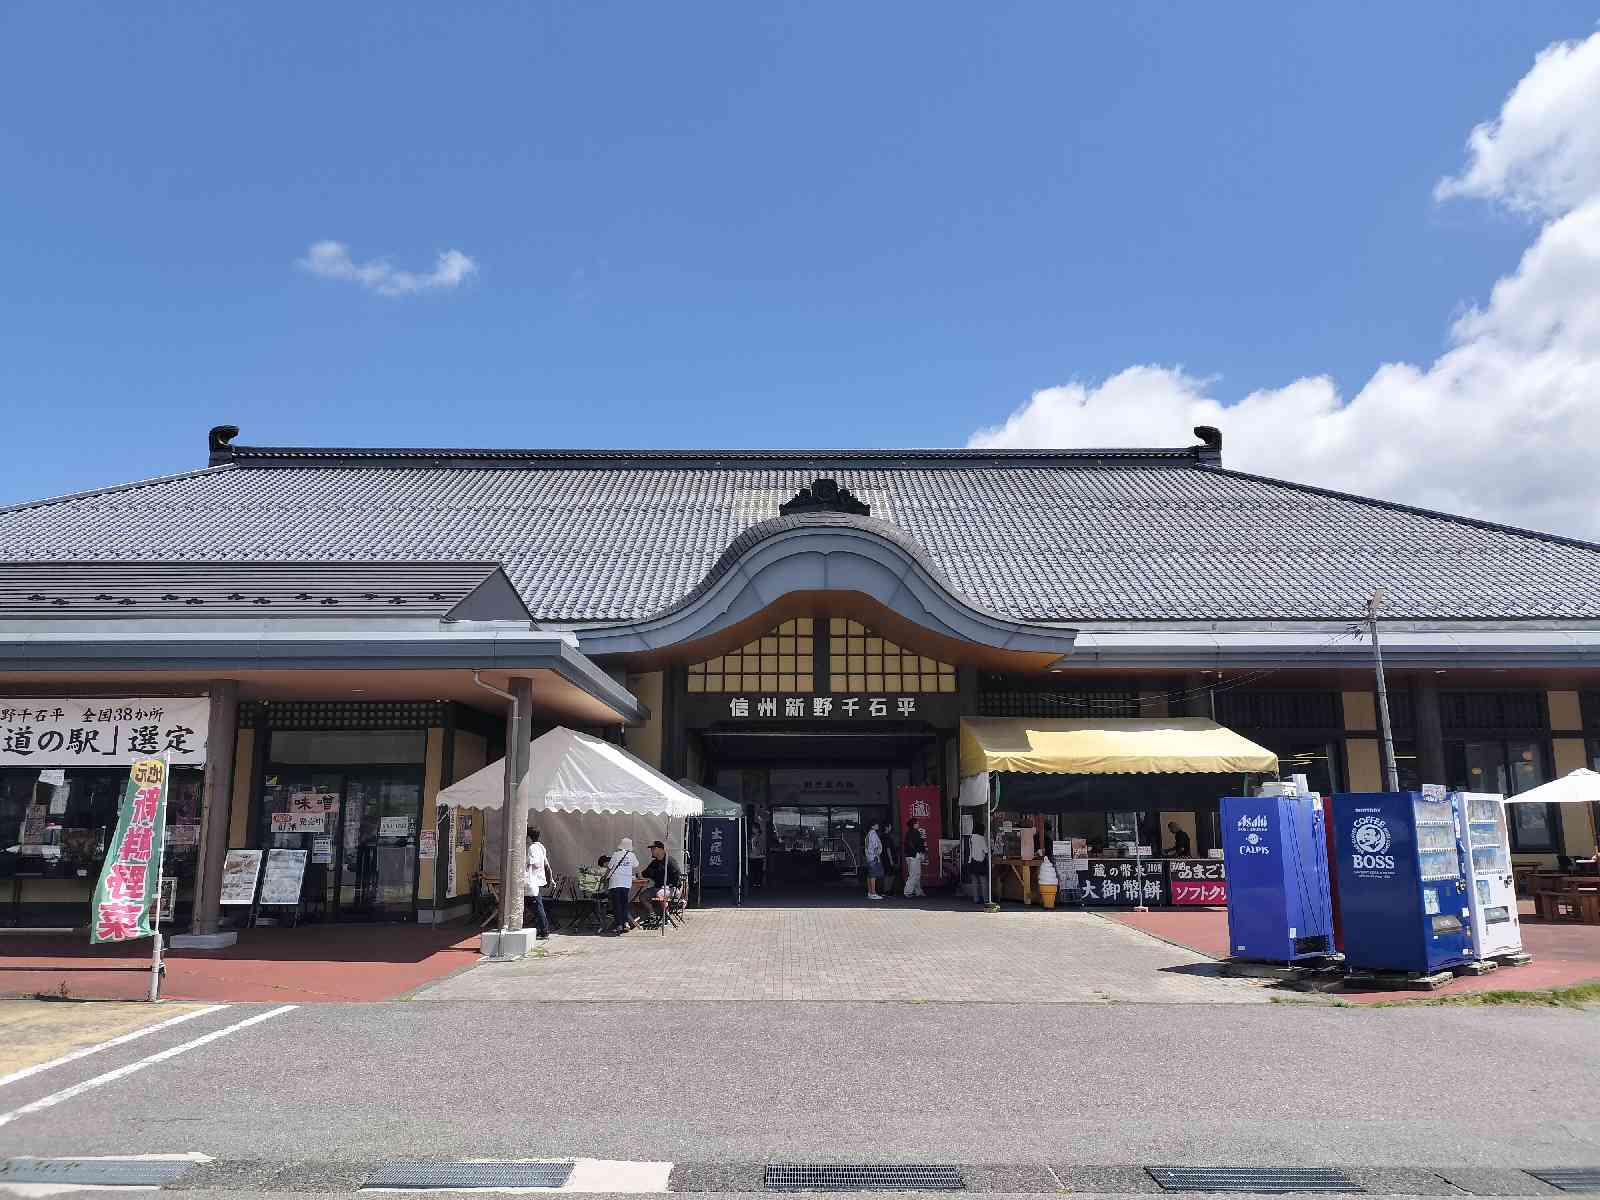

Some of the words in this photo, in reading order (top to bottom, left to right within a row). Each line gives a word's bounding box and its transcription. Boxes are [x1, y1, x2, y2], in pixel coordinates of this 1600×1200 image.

[729, 697, 916, 718] 信州新野千石平
[0, 708, 65, 723] 野千石平
[81, 707, 165, 723] 全国38か所
[0, 725, 195, 756] 道の駅」選定
[1238, 814, 1268, 828] Asahi
[1353, 816, 1386, 828] COFFEE
[1240, 845, 1271, 855] CALPIS
[1352, 855, 1395, 869] BOSS
